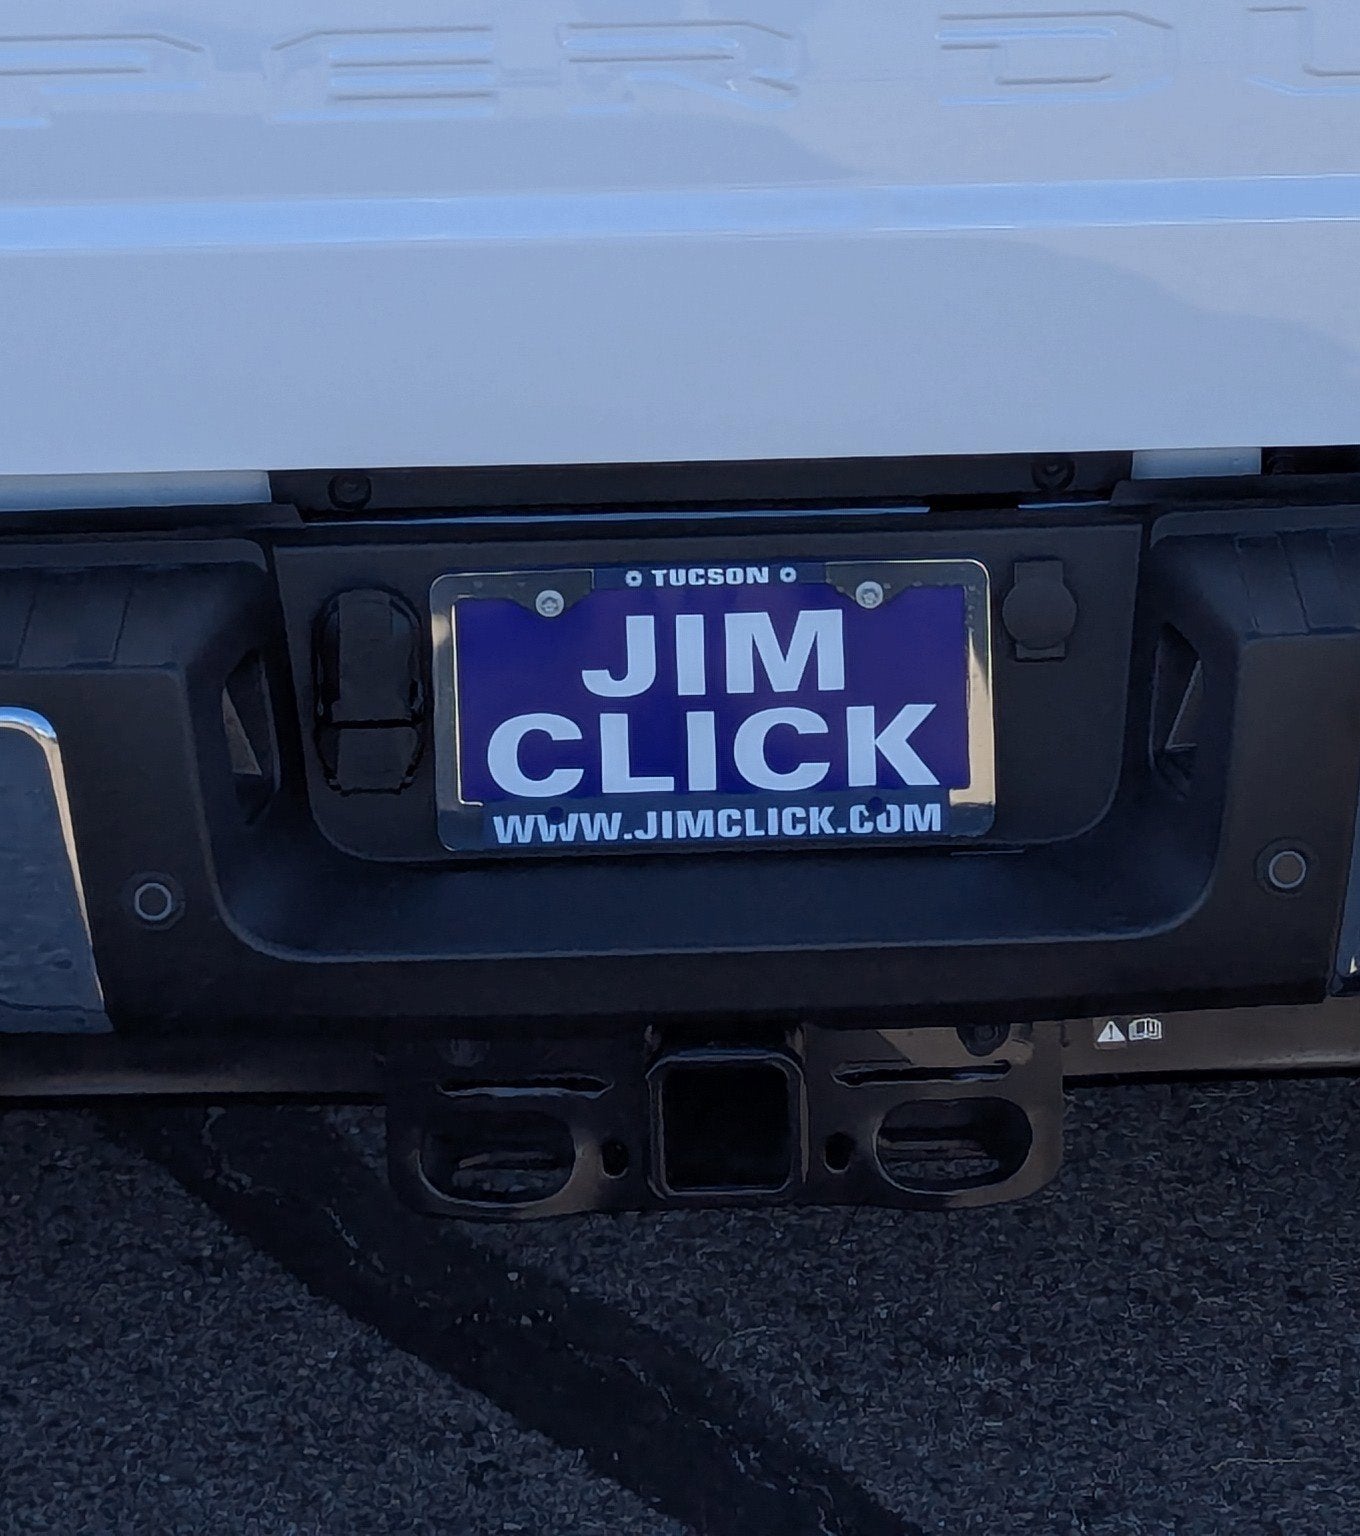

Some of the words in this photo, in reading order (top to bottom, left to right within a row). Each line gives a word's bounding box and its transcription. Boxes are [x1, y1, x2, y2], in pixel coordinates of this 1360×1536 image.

[651, 567, 770, 587] TUCSON
[581, 608, 845, 698] JIM
[486, 703, 940, 798] CLICK
[492, 802, 942, 845] WWW.JIMCLICK.COM
